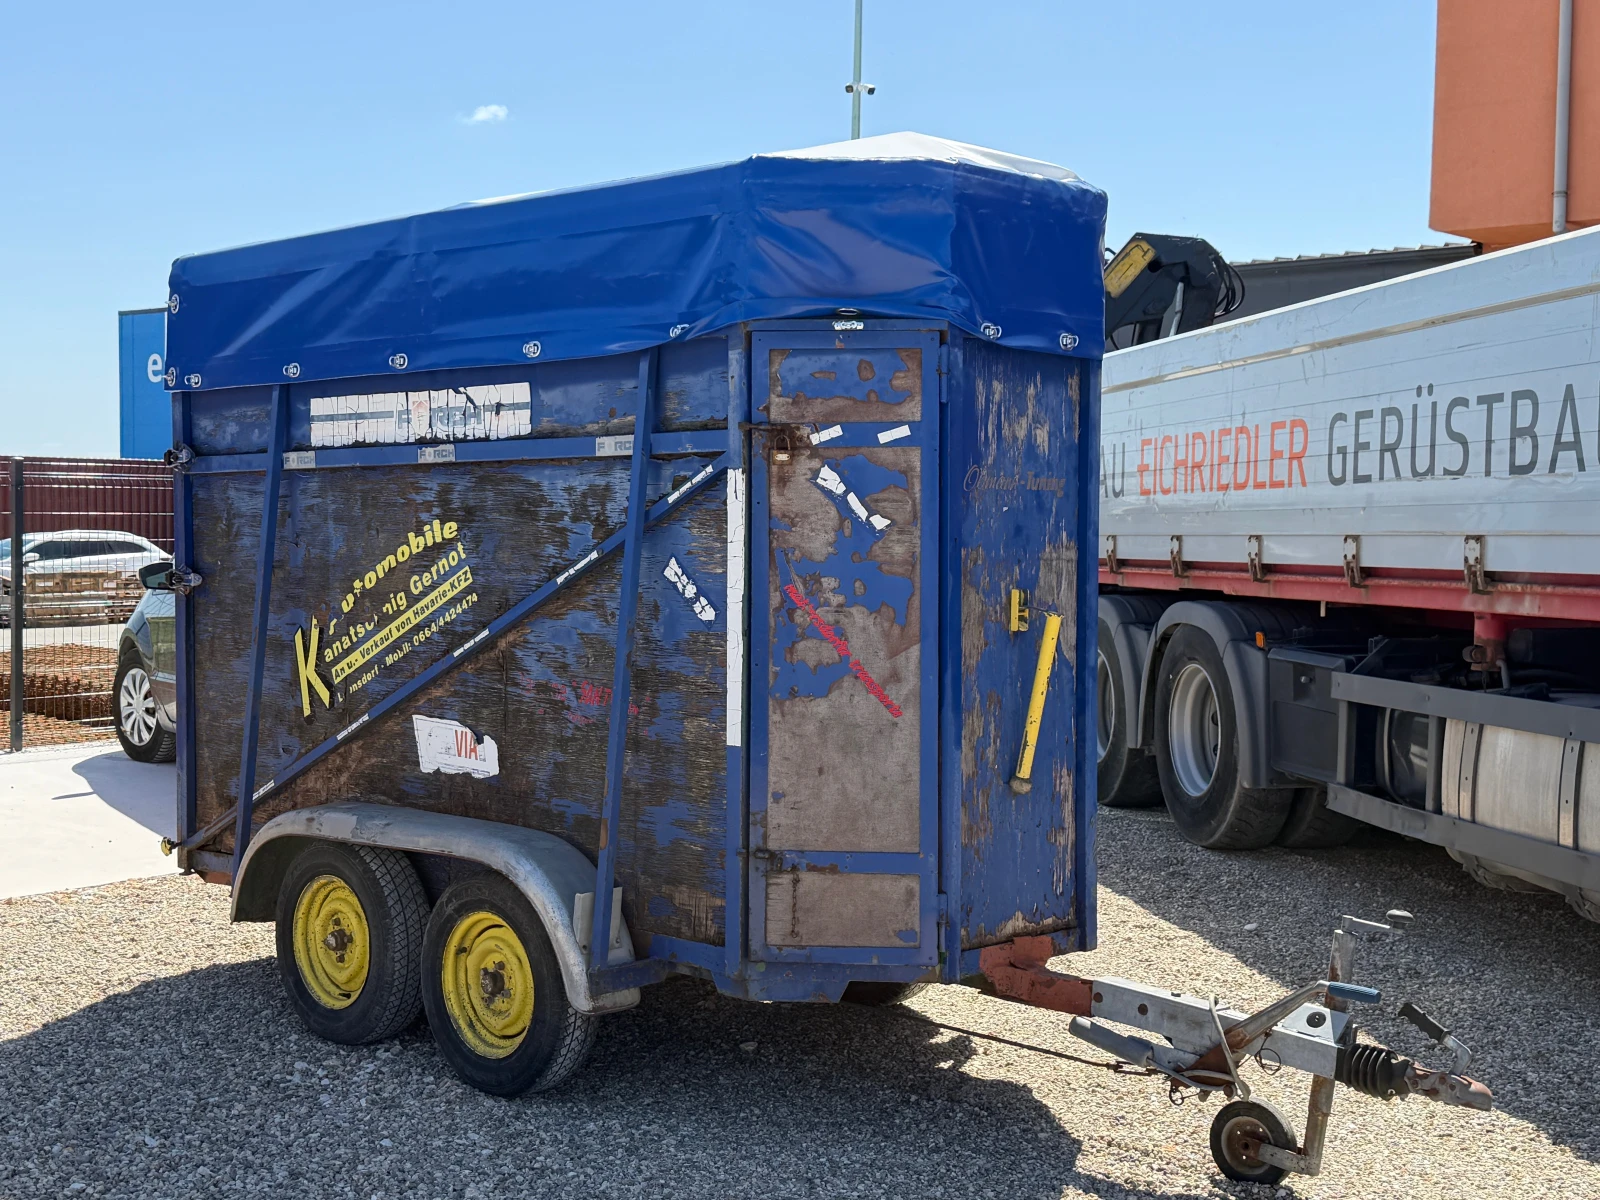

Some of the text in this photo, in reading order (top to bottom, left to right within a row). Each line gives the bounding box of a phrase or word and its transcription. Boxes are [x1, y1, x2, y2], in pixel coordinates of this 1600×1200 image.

[1137, 418, 1309, 497] EICHRIEDLER
[1327, 380, 1600, 487] GERÜSTBA
[409, 541, 467, 595] Gernot
[334, 667, 346, 680] An
[359, 627, 394, 660] Verkauf
[394, 616, 413, 634] von
[412, 568, 471, 621] Havarie-KFZ
[413, 592, 478, 646] 0664/4424474
